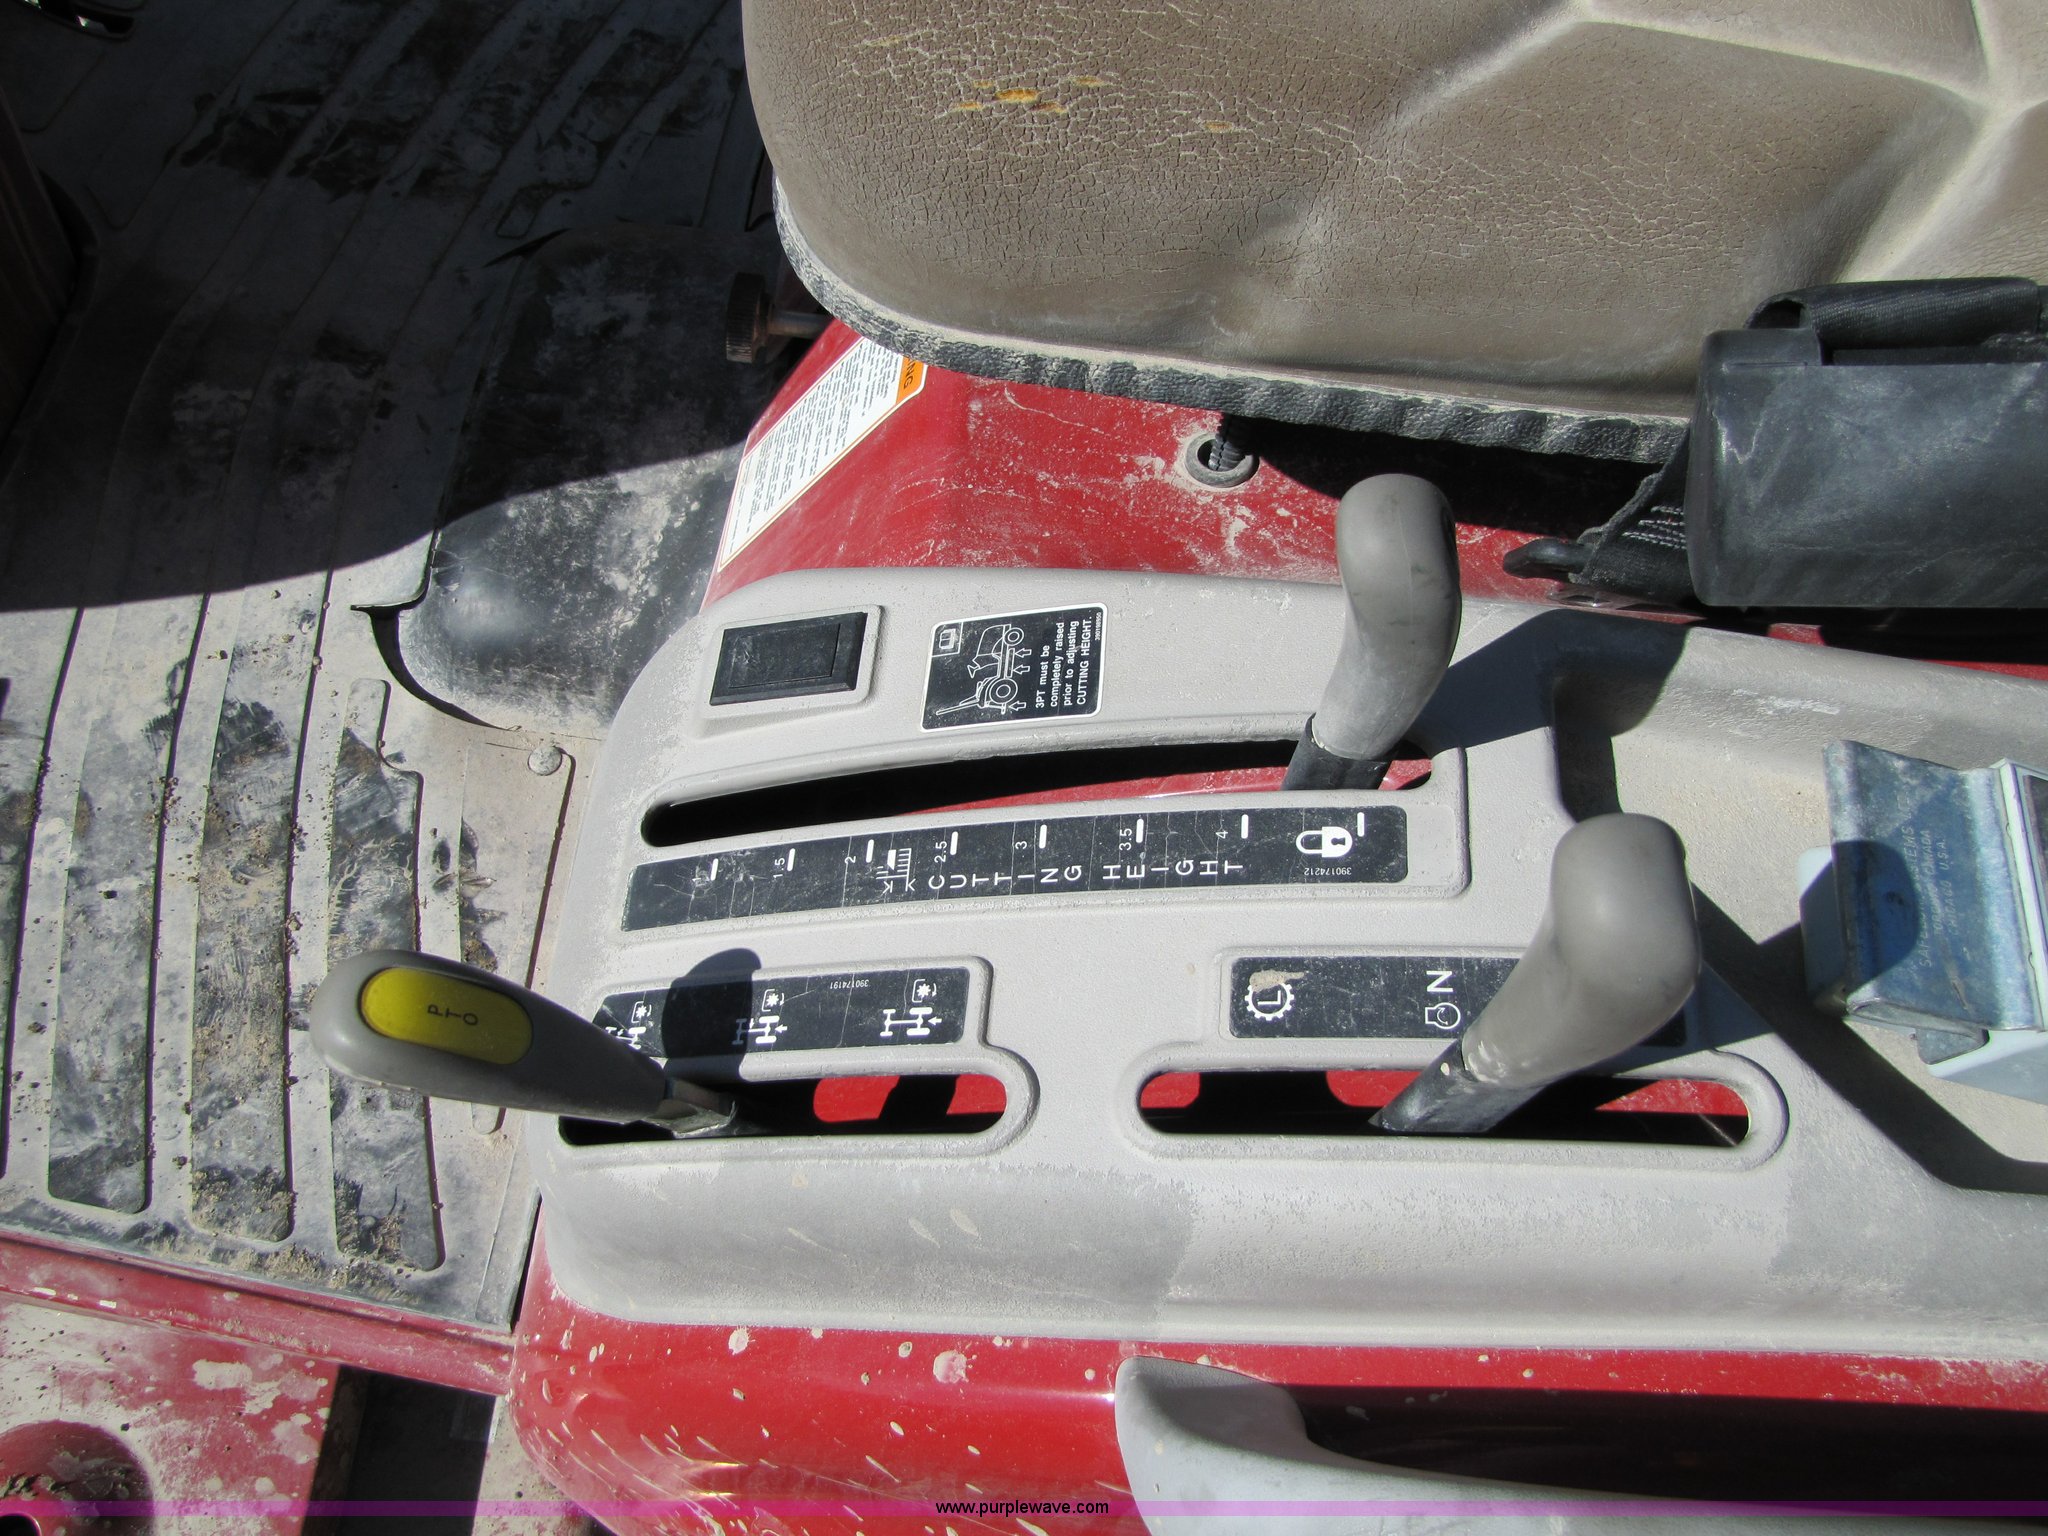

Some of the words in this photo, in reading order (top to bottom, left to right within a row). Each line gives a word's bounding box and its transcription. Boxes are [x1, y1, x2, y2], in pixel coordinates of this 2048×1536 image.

[1054, 622, 1065, 651] raised
[1066, 620, 1080, 664] adjusting
[1081, 616, 1093, 657] HEIGHT.
[1041, 645, 1050, 657] be
[1039, 661, 1048, 685] must
[1050, 655, 1064, 707] completely
[1065, 669, 1073, 679] to
[1076, 661, 1089, 705] CUTTING
[1035, 690, 1046, 709] 3PT
[1063, 683, 1073, 706] prior
[1015, 840, 1028, 850] 3
[1119, 828, 1133, 851] 3.5
[1215, 829, 1229, 840] 4
[844, 855, 857, 865] 2
[934, 840, 948, 863] 2.5
[773, 857, 786, 879] 1.5
[928, 864, 1082, 890] CUTTING
[1102, 859, 1243, 880] HEIGHT
[1304, 866, 1352, 876] 390174212
[1425, 970, 1454, 993] N
[1257, 989, 1282, 1005] L
[427, 1003, 479, 1026] PTO
